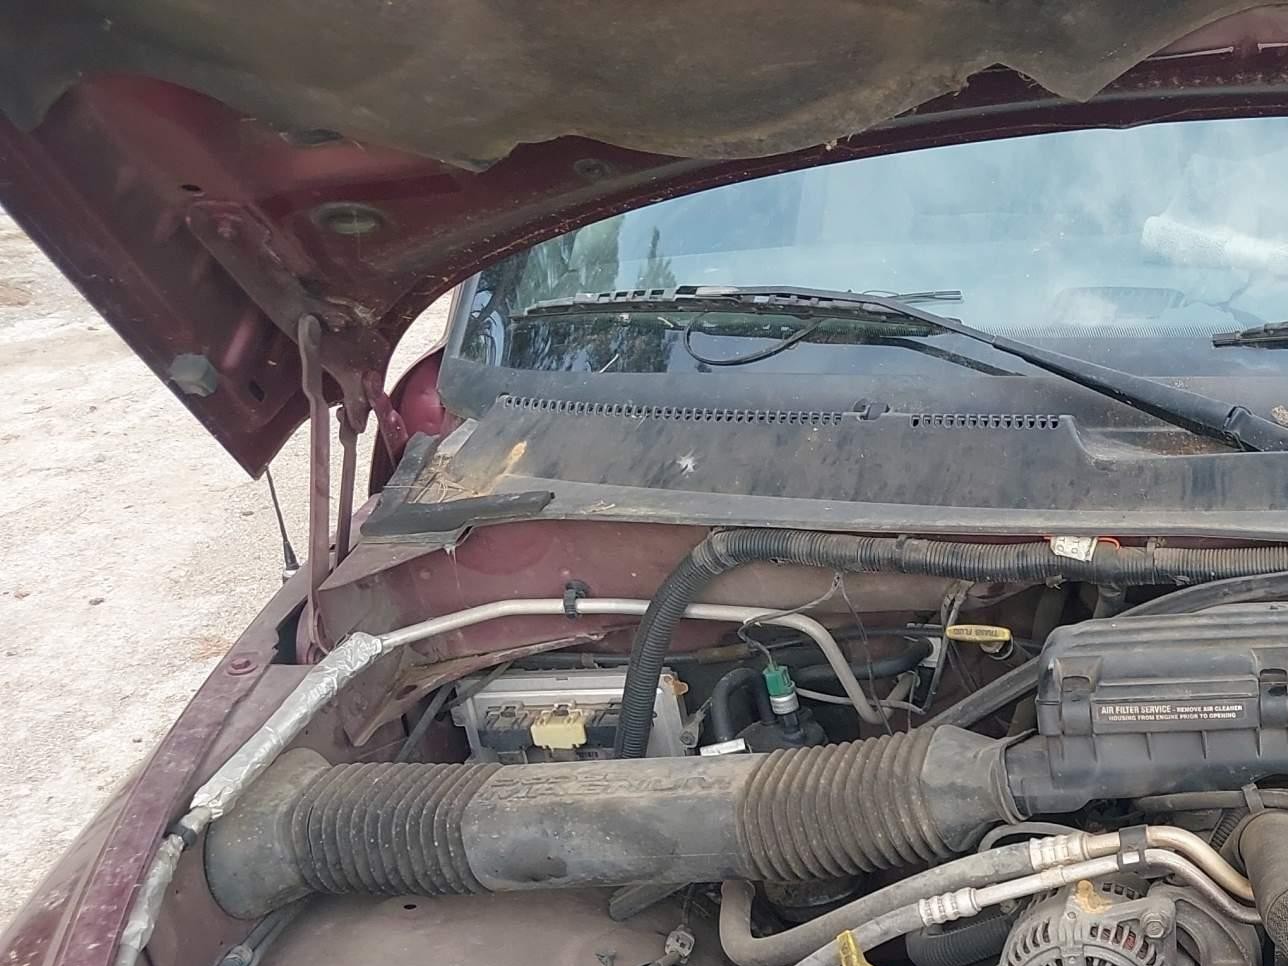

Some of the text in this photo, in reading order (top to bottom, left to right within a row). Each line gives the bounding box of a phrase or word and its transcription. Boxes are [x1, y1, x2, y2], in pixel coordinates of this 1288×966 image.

[1101, 705, 1115, 714] AIR
[1115, 705, 1140, 714] FILTER
[1140, 705, 1171, 714] SERVICE
